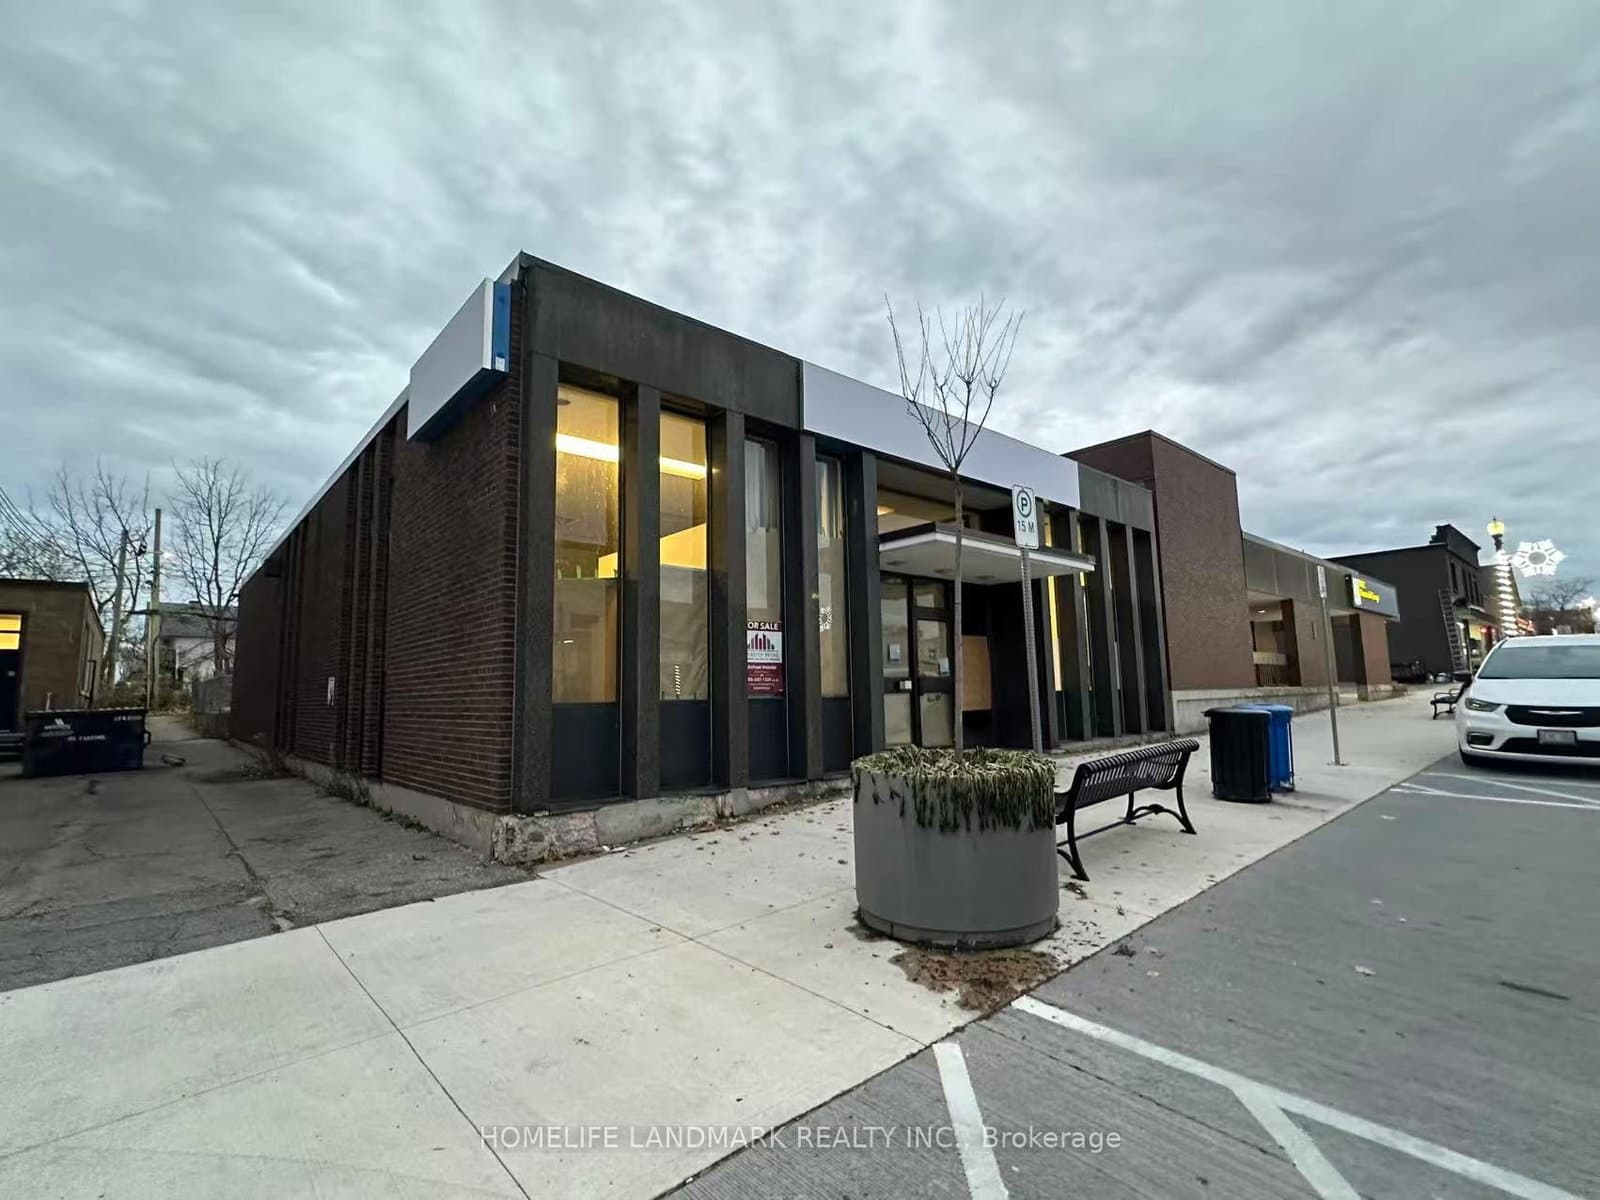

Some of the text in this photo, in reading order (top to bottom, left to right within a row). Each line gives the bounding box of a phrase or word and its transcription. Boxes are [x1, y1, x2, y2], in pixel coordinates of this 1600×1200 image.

[1021, 497, 1028, 511] P
[1017, 520, 1027, 533] 15
[747, 621, 779, 630] OR SALE
